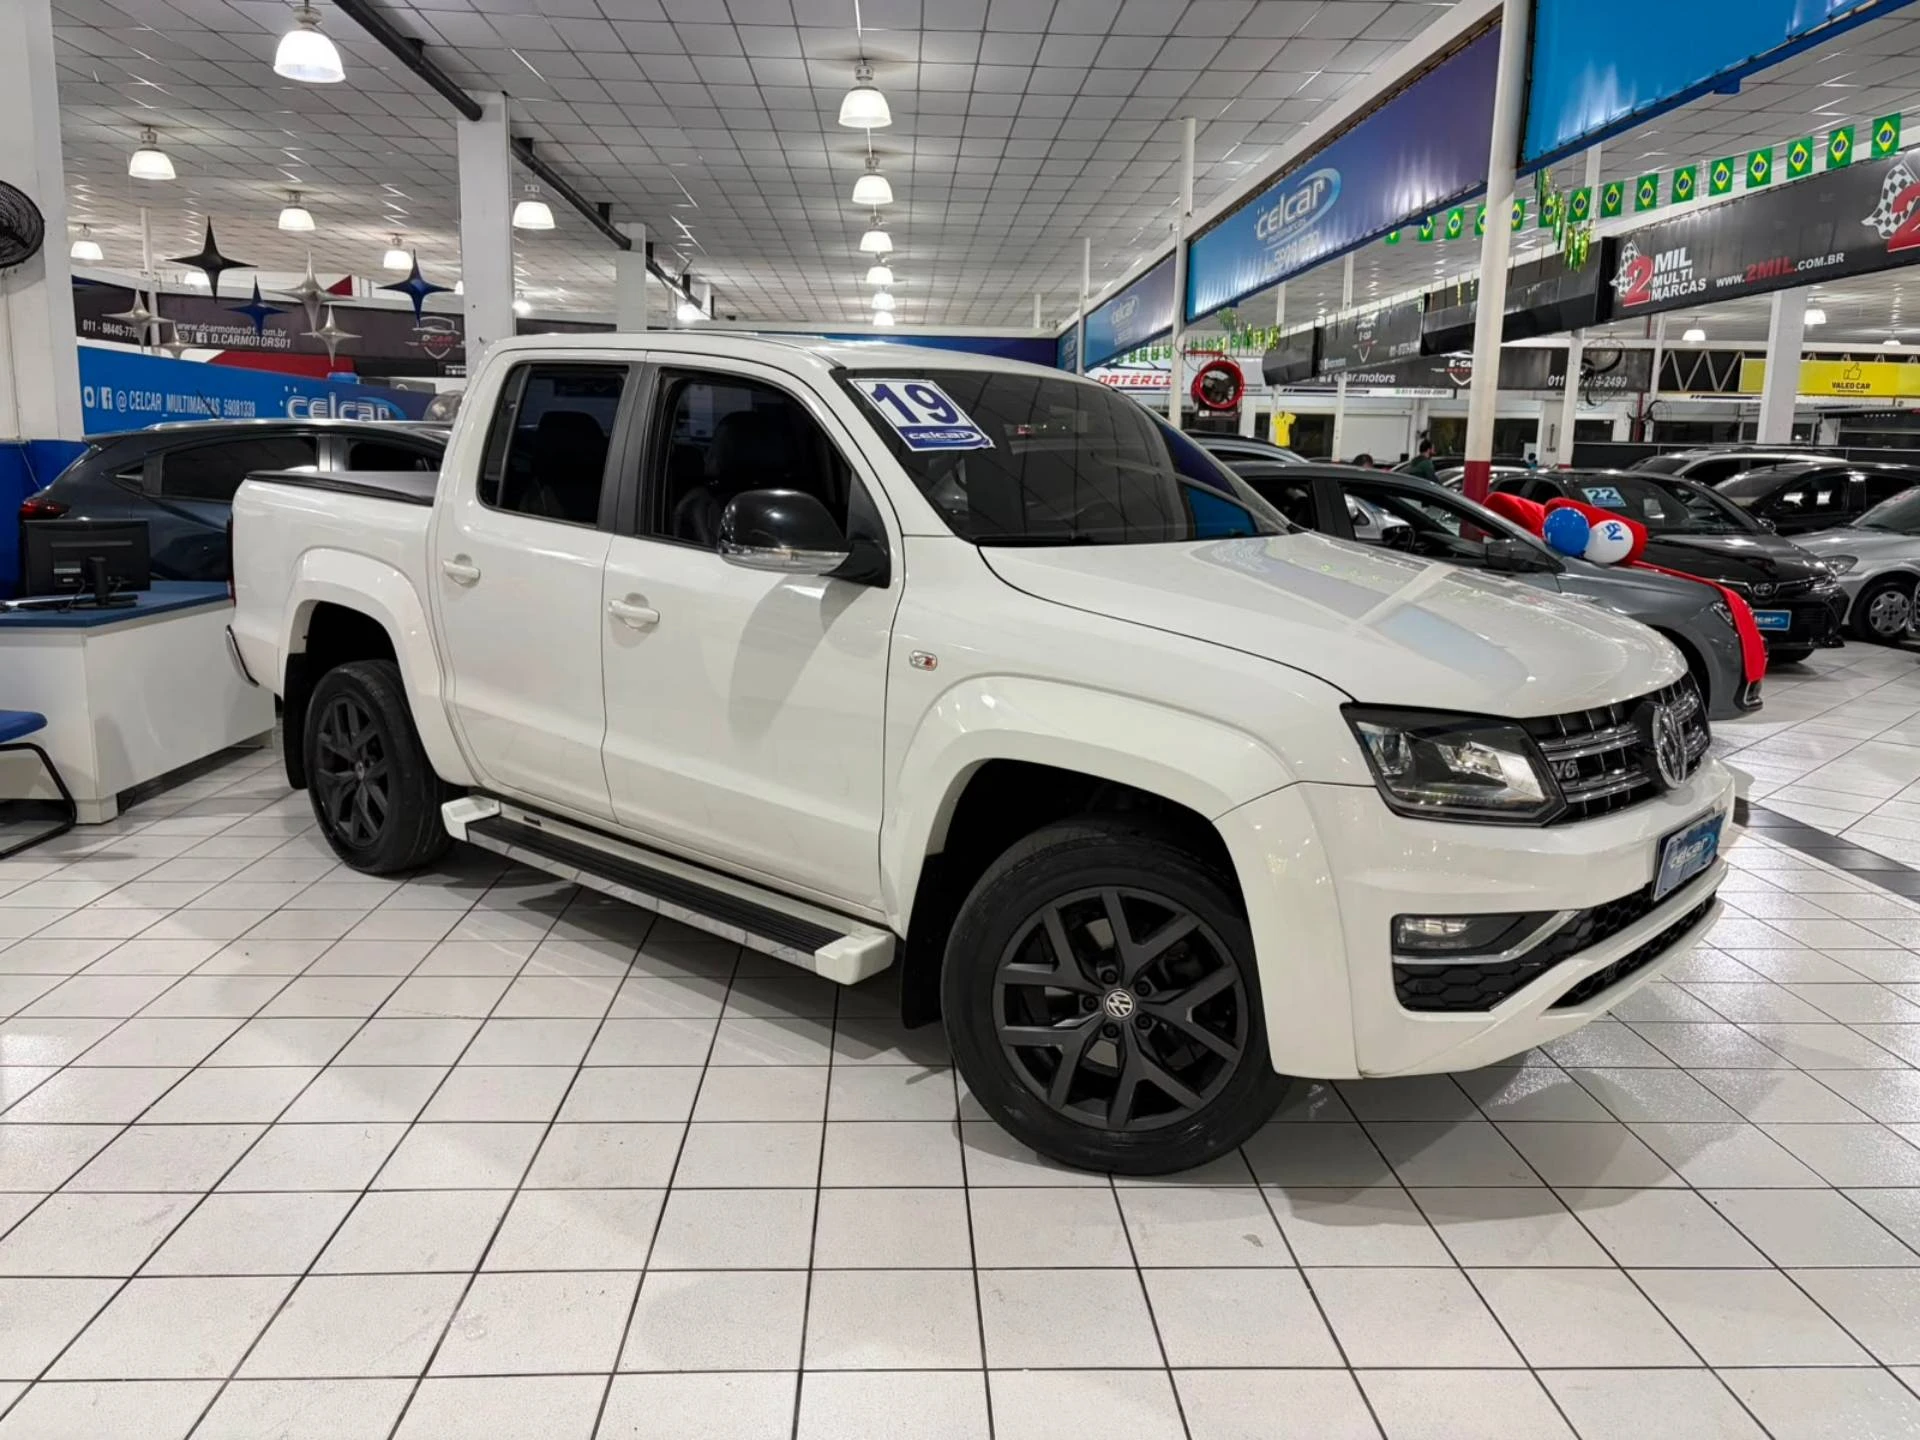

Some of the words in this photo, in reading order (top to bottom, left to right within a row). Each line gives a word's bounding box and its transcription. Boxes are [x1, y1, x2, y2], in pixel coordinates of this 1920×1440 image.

[1256, 178, 1326, 241] celcar
[1654, 247, 1693, 275] MIL
[1652, 266, 1694, 288] MULTI
[1651, 278, 1707, 303] MARCAS
[82, 320, 97, 333] 011
[177, 322, 287, 338] www.dcarmotors01.om.br
[210, 335, 291, 349] D.CARMOTORS01
[1547, 375, 1565, 387] 011
[286, 391, 392, 422] celcar
[871, 383, 959, 424] 19
[908, 431, 970, 440] celcar
[1587, 489, 1618, 500] 22
[1553, 759, 1577, 780] V6
